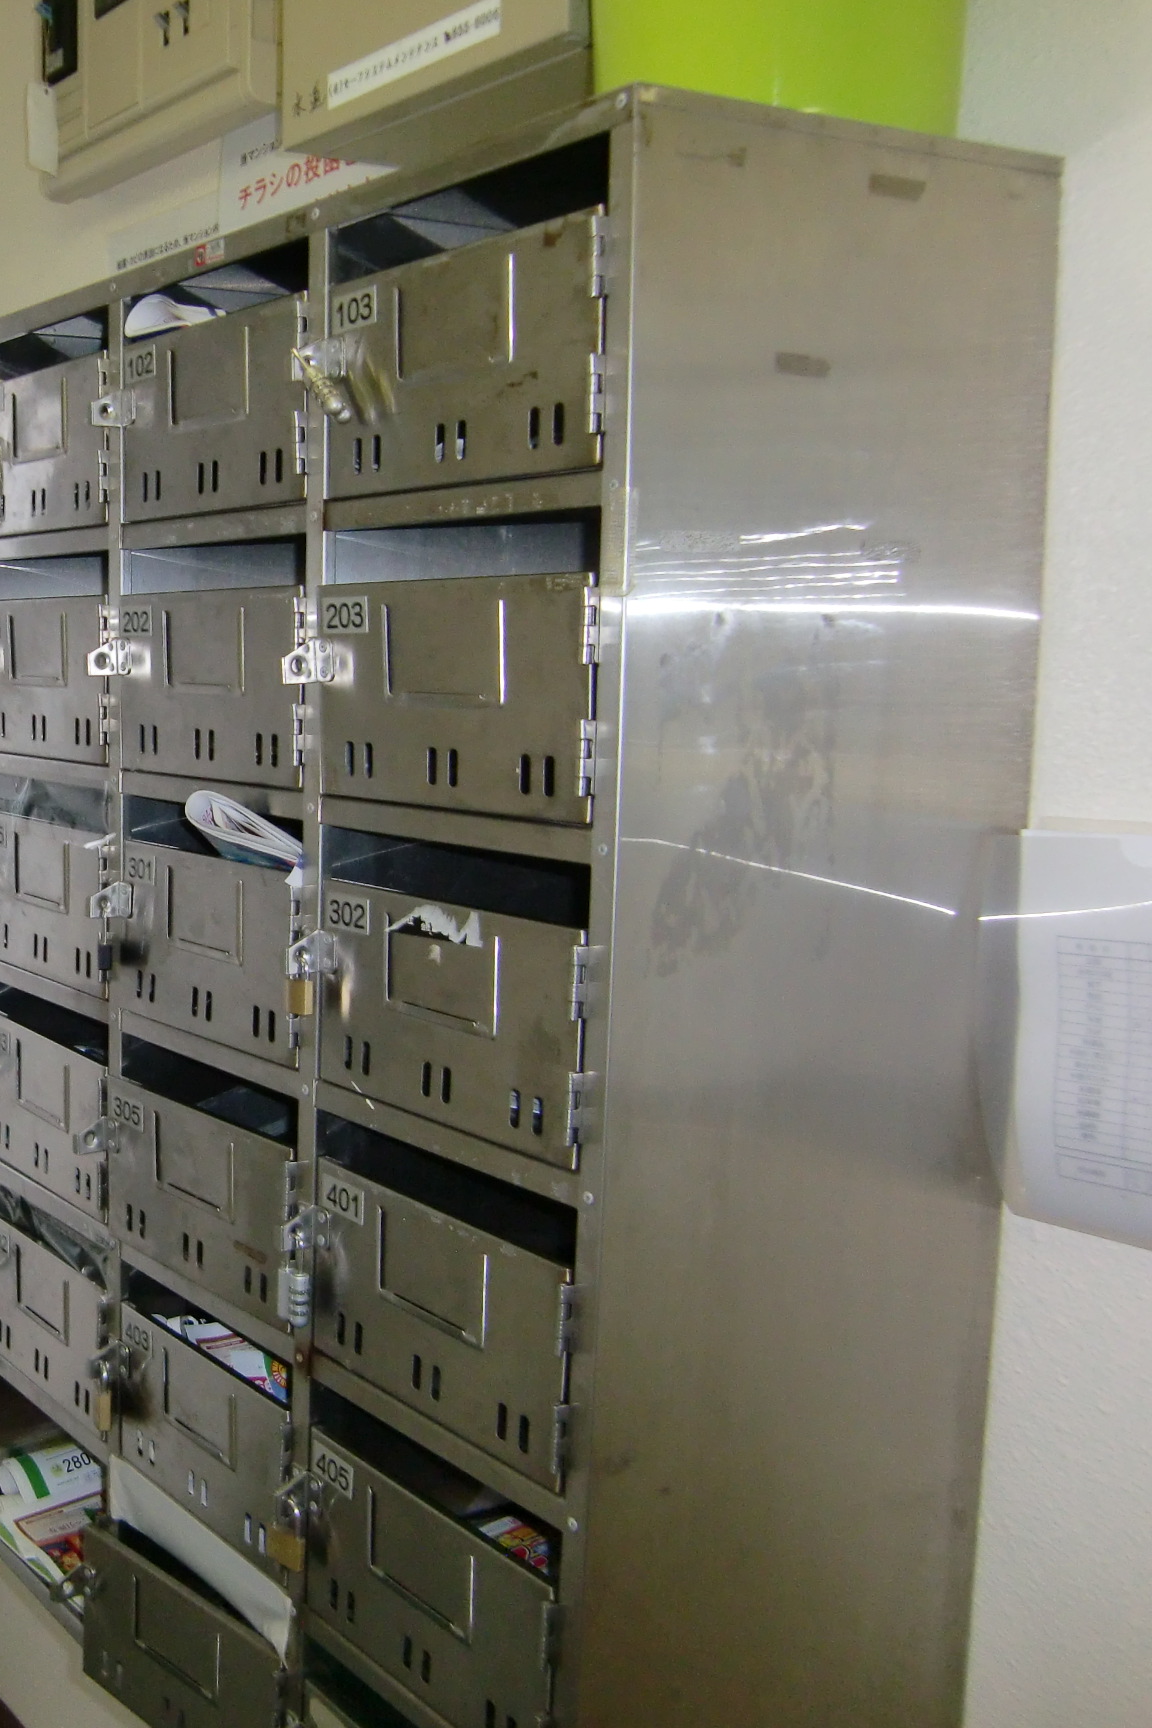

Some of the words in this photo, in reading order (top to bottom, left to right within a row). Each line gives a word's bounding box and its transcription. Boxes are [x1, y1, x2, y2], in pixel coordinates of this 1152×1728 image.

[336, 296, 373, 327] 103
[127, 352, 154, 380] 102
[123, 611, 149, 632] 202
[326, 603, 365, 630] 203
[128, 857, 152, 880] 301
[329, 900, 366, 928] 302
[113, 1097, 141, 1125] 305
[326, 1183, 360, 1214] 401
[125, 1323, 149, 1351] 403
[62, 1452, 92, 1473] 280
[316, 1453, 350, 1491] 405
